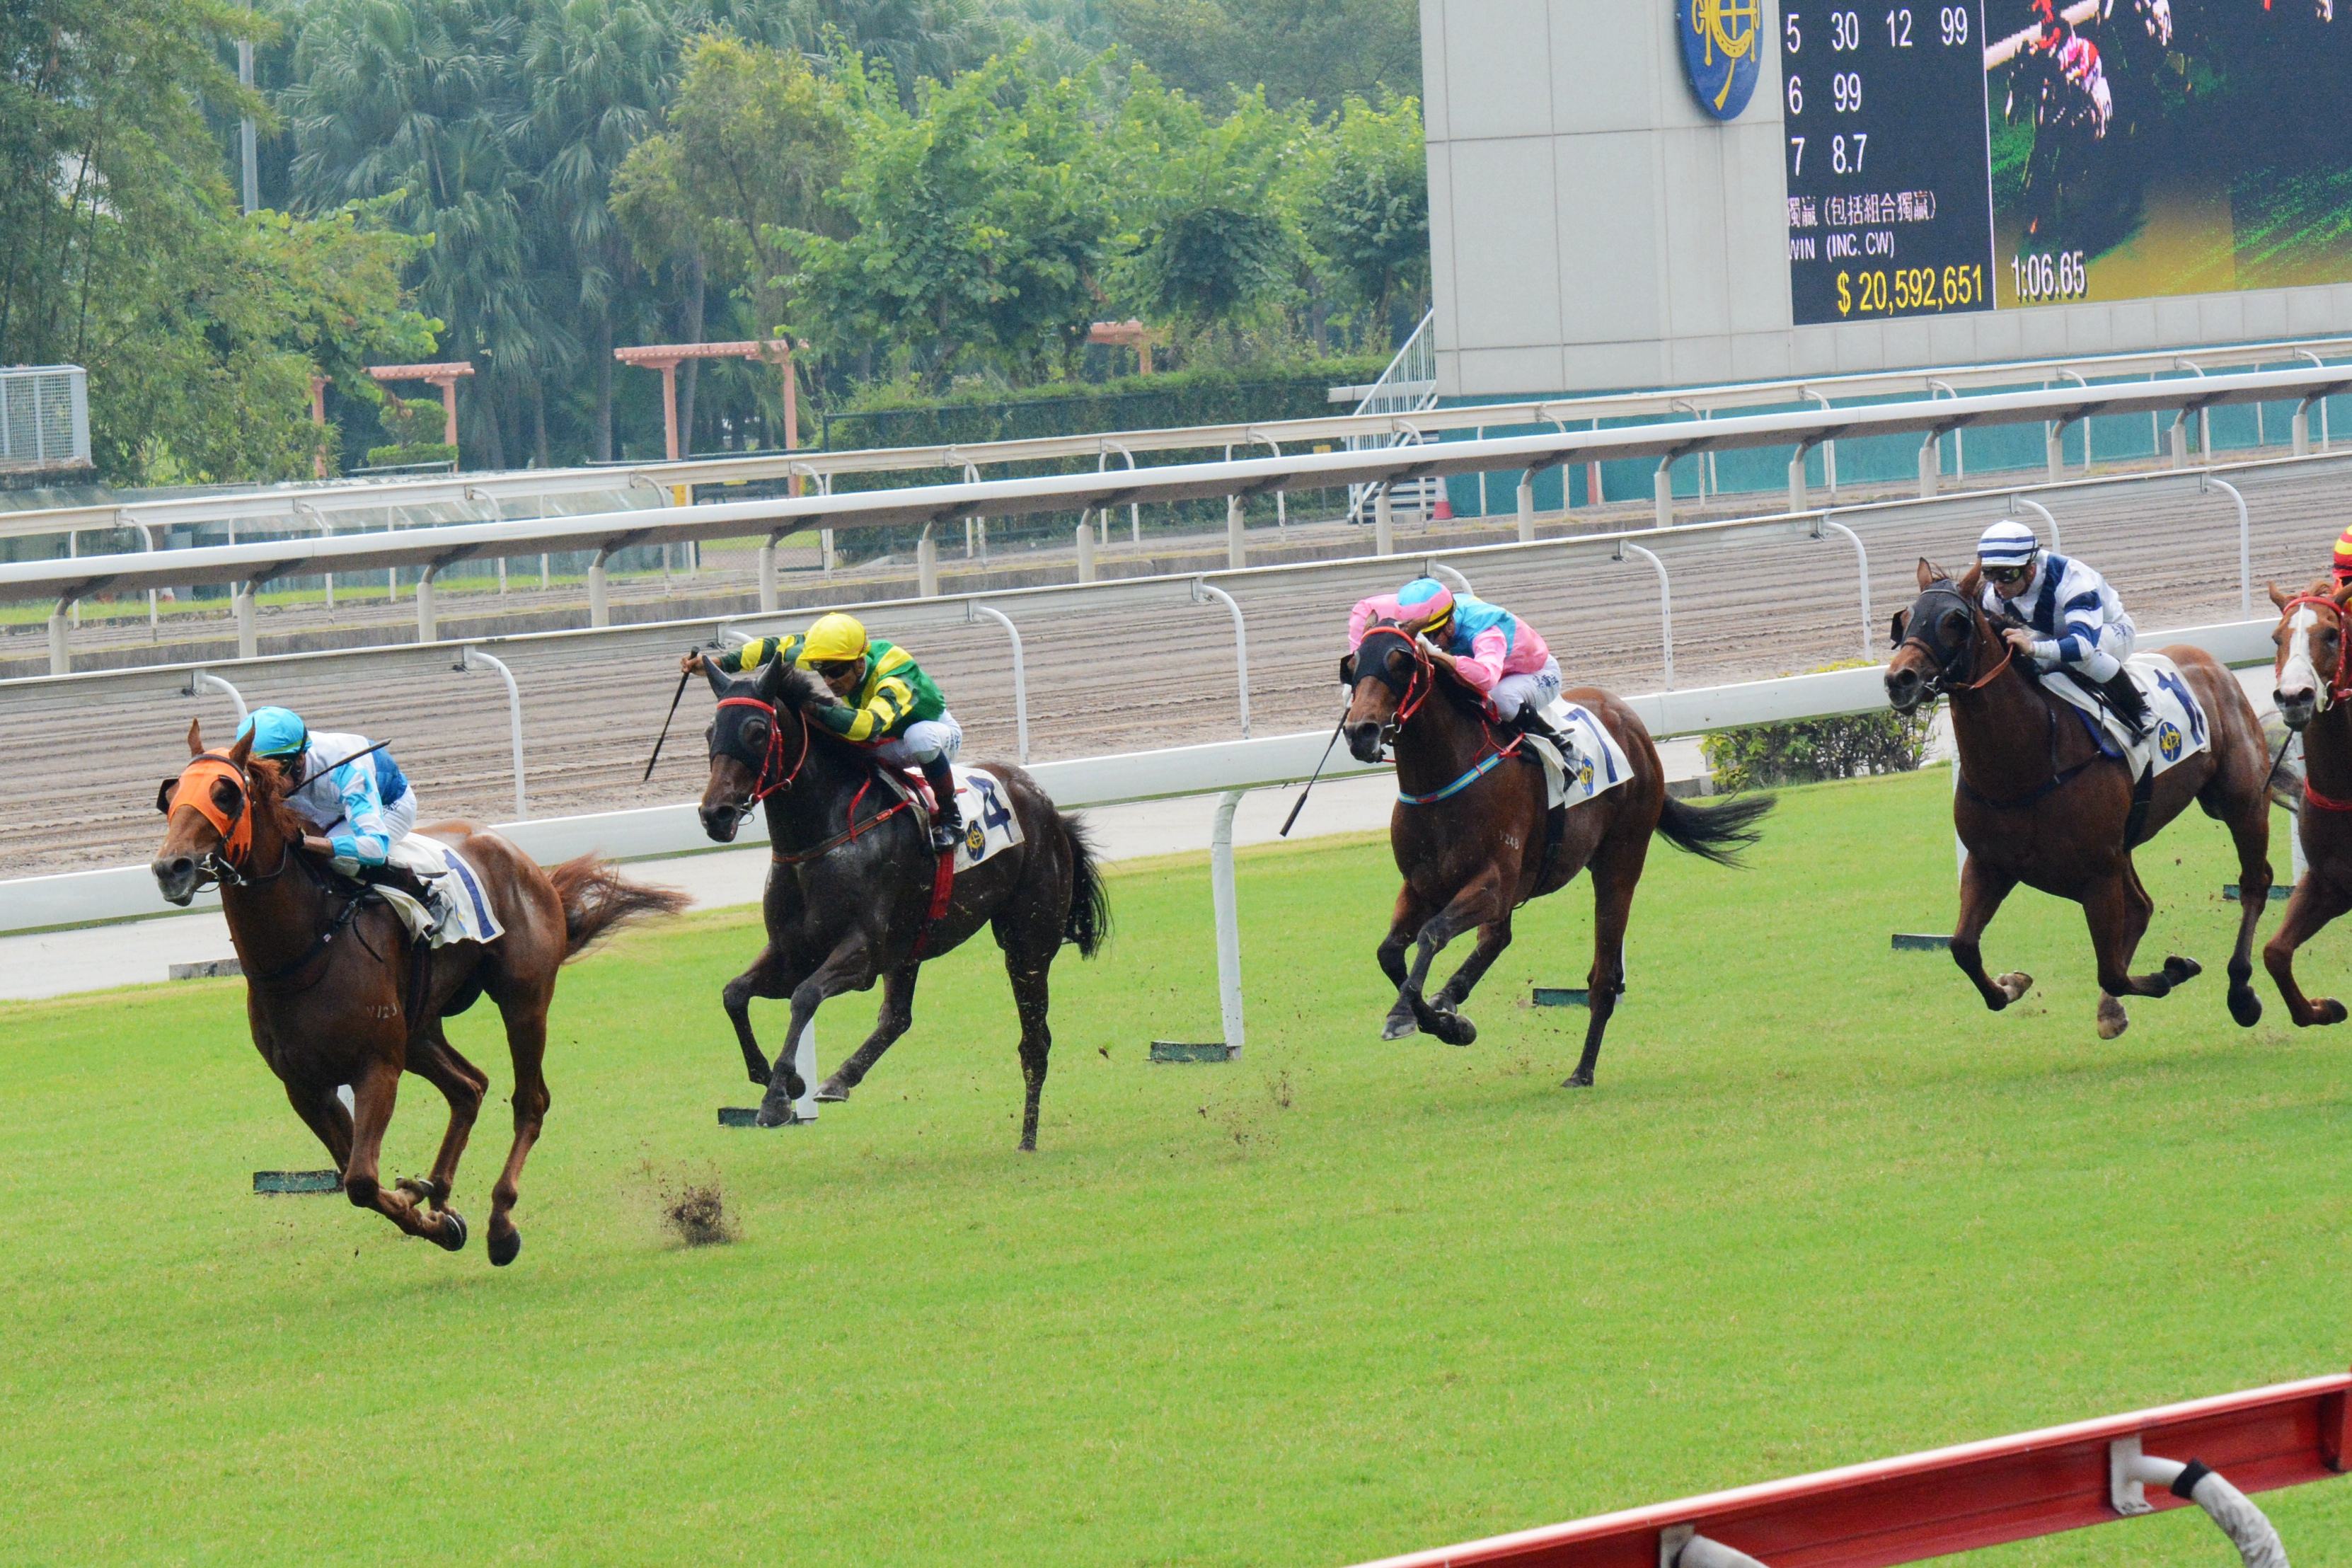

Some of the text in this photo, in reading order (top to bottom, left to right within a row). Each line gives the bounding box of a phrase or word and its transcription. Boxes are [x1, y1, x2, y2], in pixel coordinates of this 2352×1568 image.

[1787, 6, 1968, 53] 5 30 12 99
[1788, 73, 1862, 113] 6 99
[1791, 133, 1867, 176] 7 8.7
[1826, 233, 1862, 263] (INC.
[1865, 231, 1894, 259] CW)
[1859, 264, 1983, 316] 20,592,651
[2011, 250, 2086, 299] 1:06.65
[965, 775, 1012, 843] 4
[442, 848, 496, 940] 1
